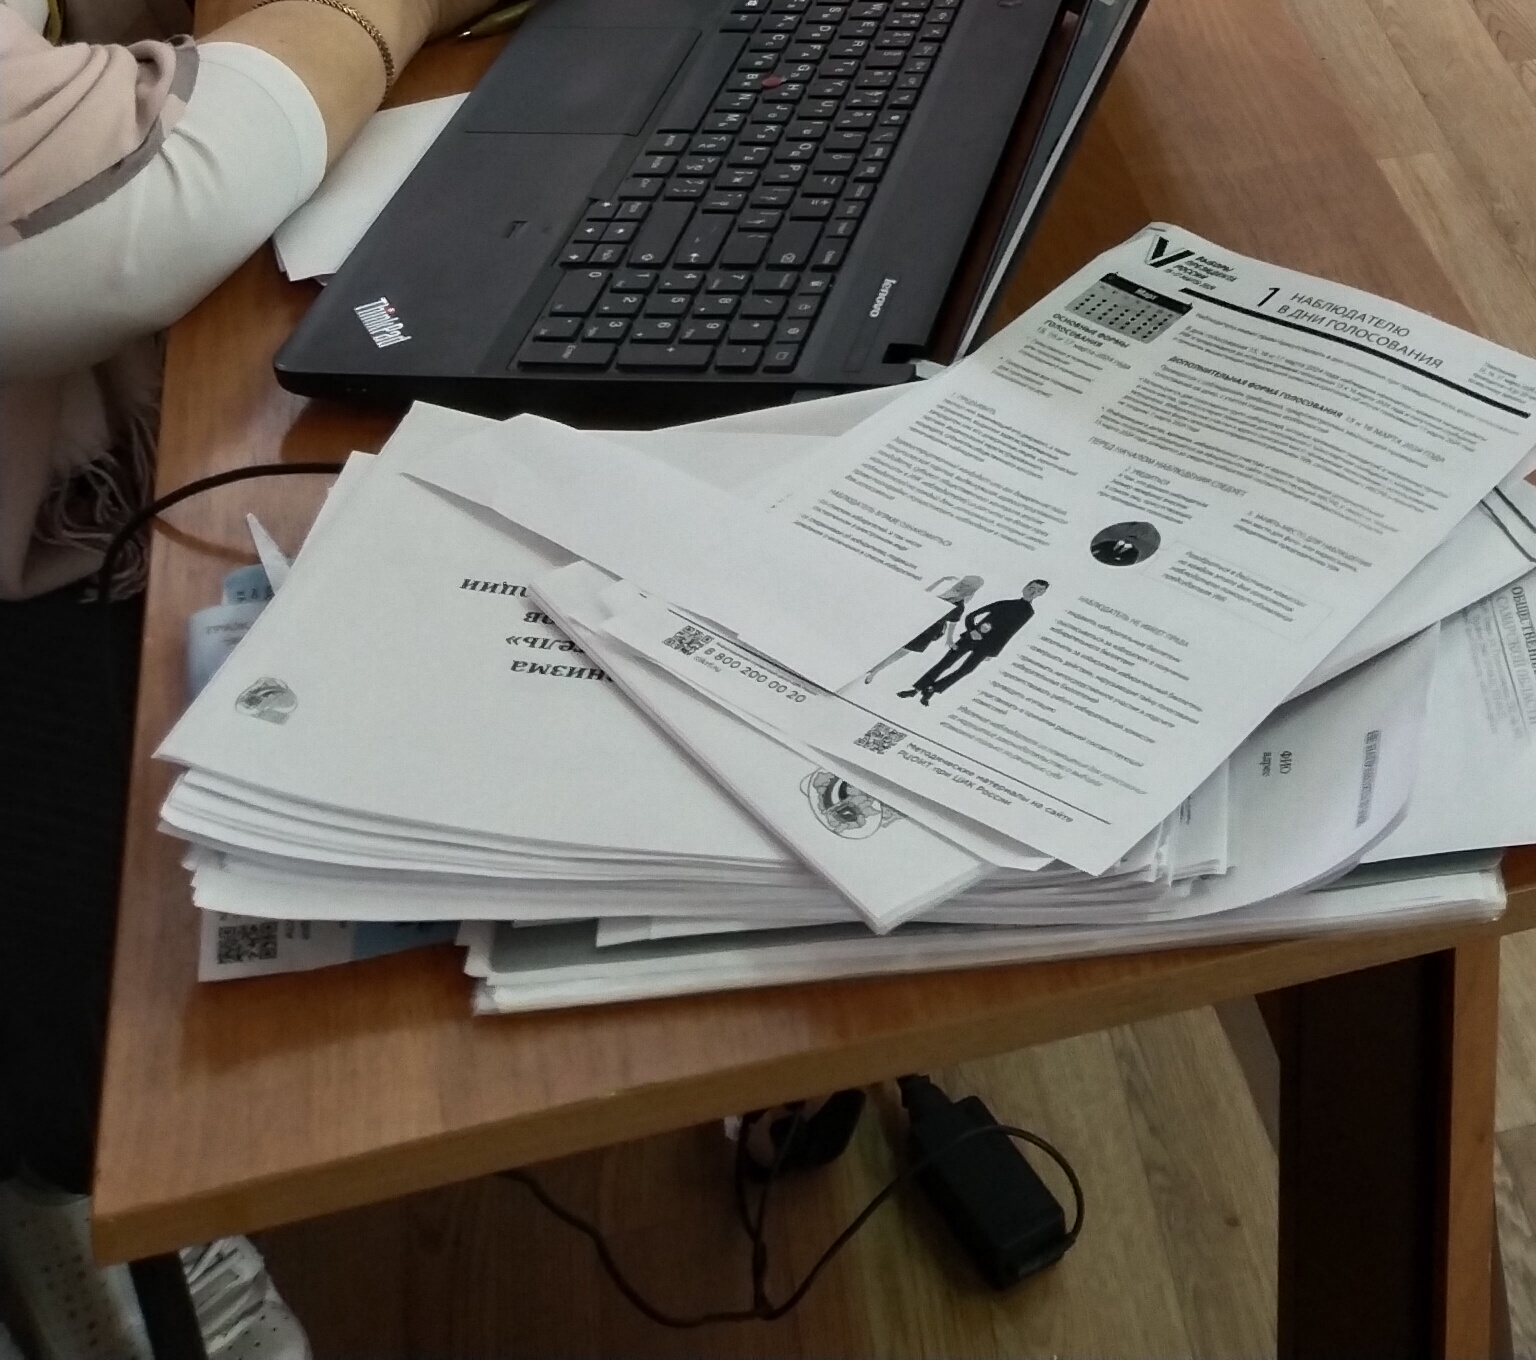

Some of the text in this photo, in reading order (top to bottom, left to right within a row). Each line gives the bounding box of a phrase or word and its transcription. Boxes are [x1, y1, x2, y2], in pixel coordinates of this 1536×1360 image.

[869, 278, 897, 318] lenovo
[1257, 287, 1281, 308] 1
[1290, 292, 1410, 337] НАБЛЮДАТЕЛЮ
[354, 296, 412, 348] ThinkPad
[1044, 320, 1104, 347] ГОЛОСОВАНИЯ
[1053, 313, 1131, 348] ОСНОВНЫЕ ФОРМЫ
[1277, 305, 1444, 369] В ДНИ ГОЛОСОВАНИЯ
[1496, 595, 1528, 668] САМАРСКОЙ
[511, 660, 613, 682] низма
[714, 652, 741, 669] 800
[740, 667, 768, 683] 200
[768, 680, 787, 693] 00
[786, 690, 807, 703] 20
[1259, 752, 1272, 777] адрес
[1280, 750, 1292, 774] ФИО
[906, 742, 975, 777] Методические
[976, 776, 1030, 803] материалы
[1045, 808, 1074, 823] сайте
[951, 775, 976, 789] ЦИК
[976, 786, 1012, 806] России
